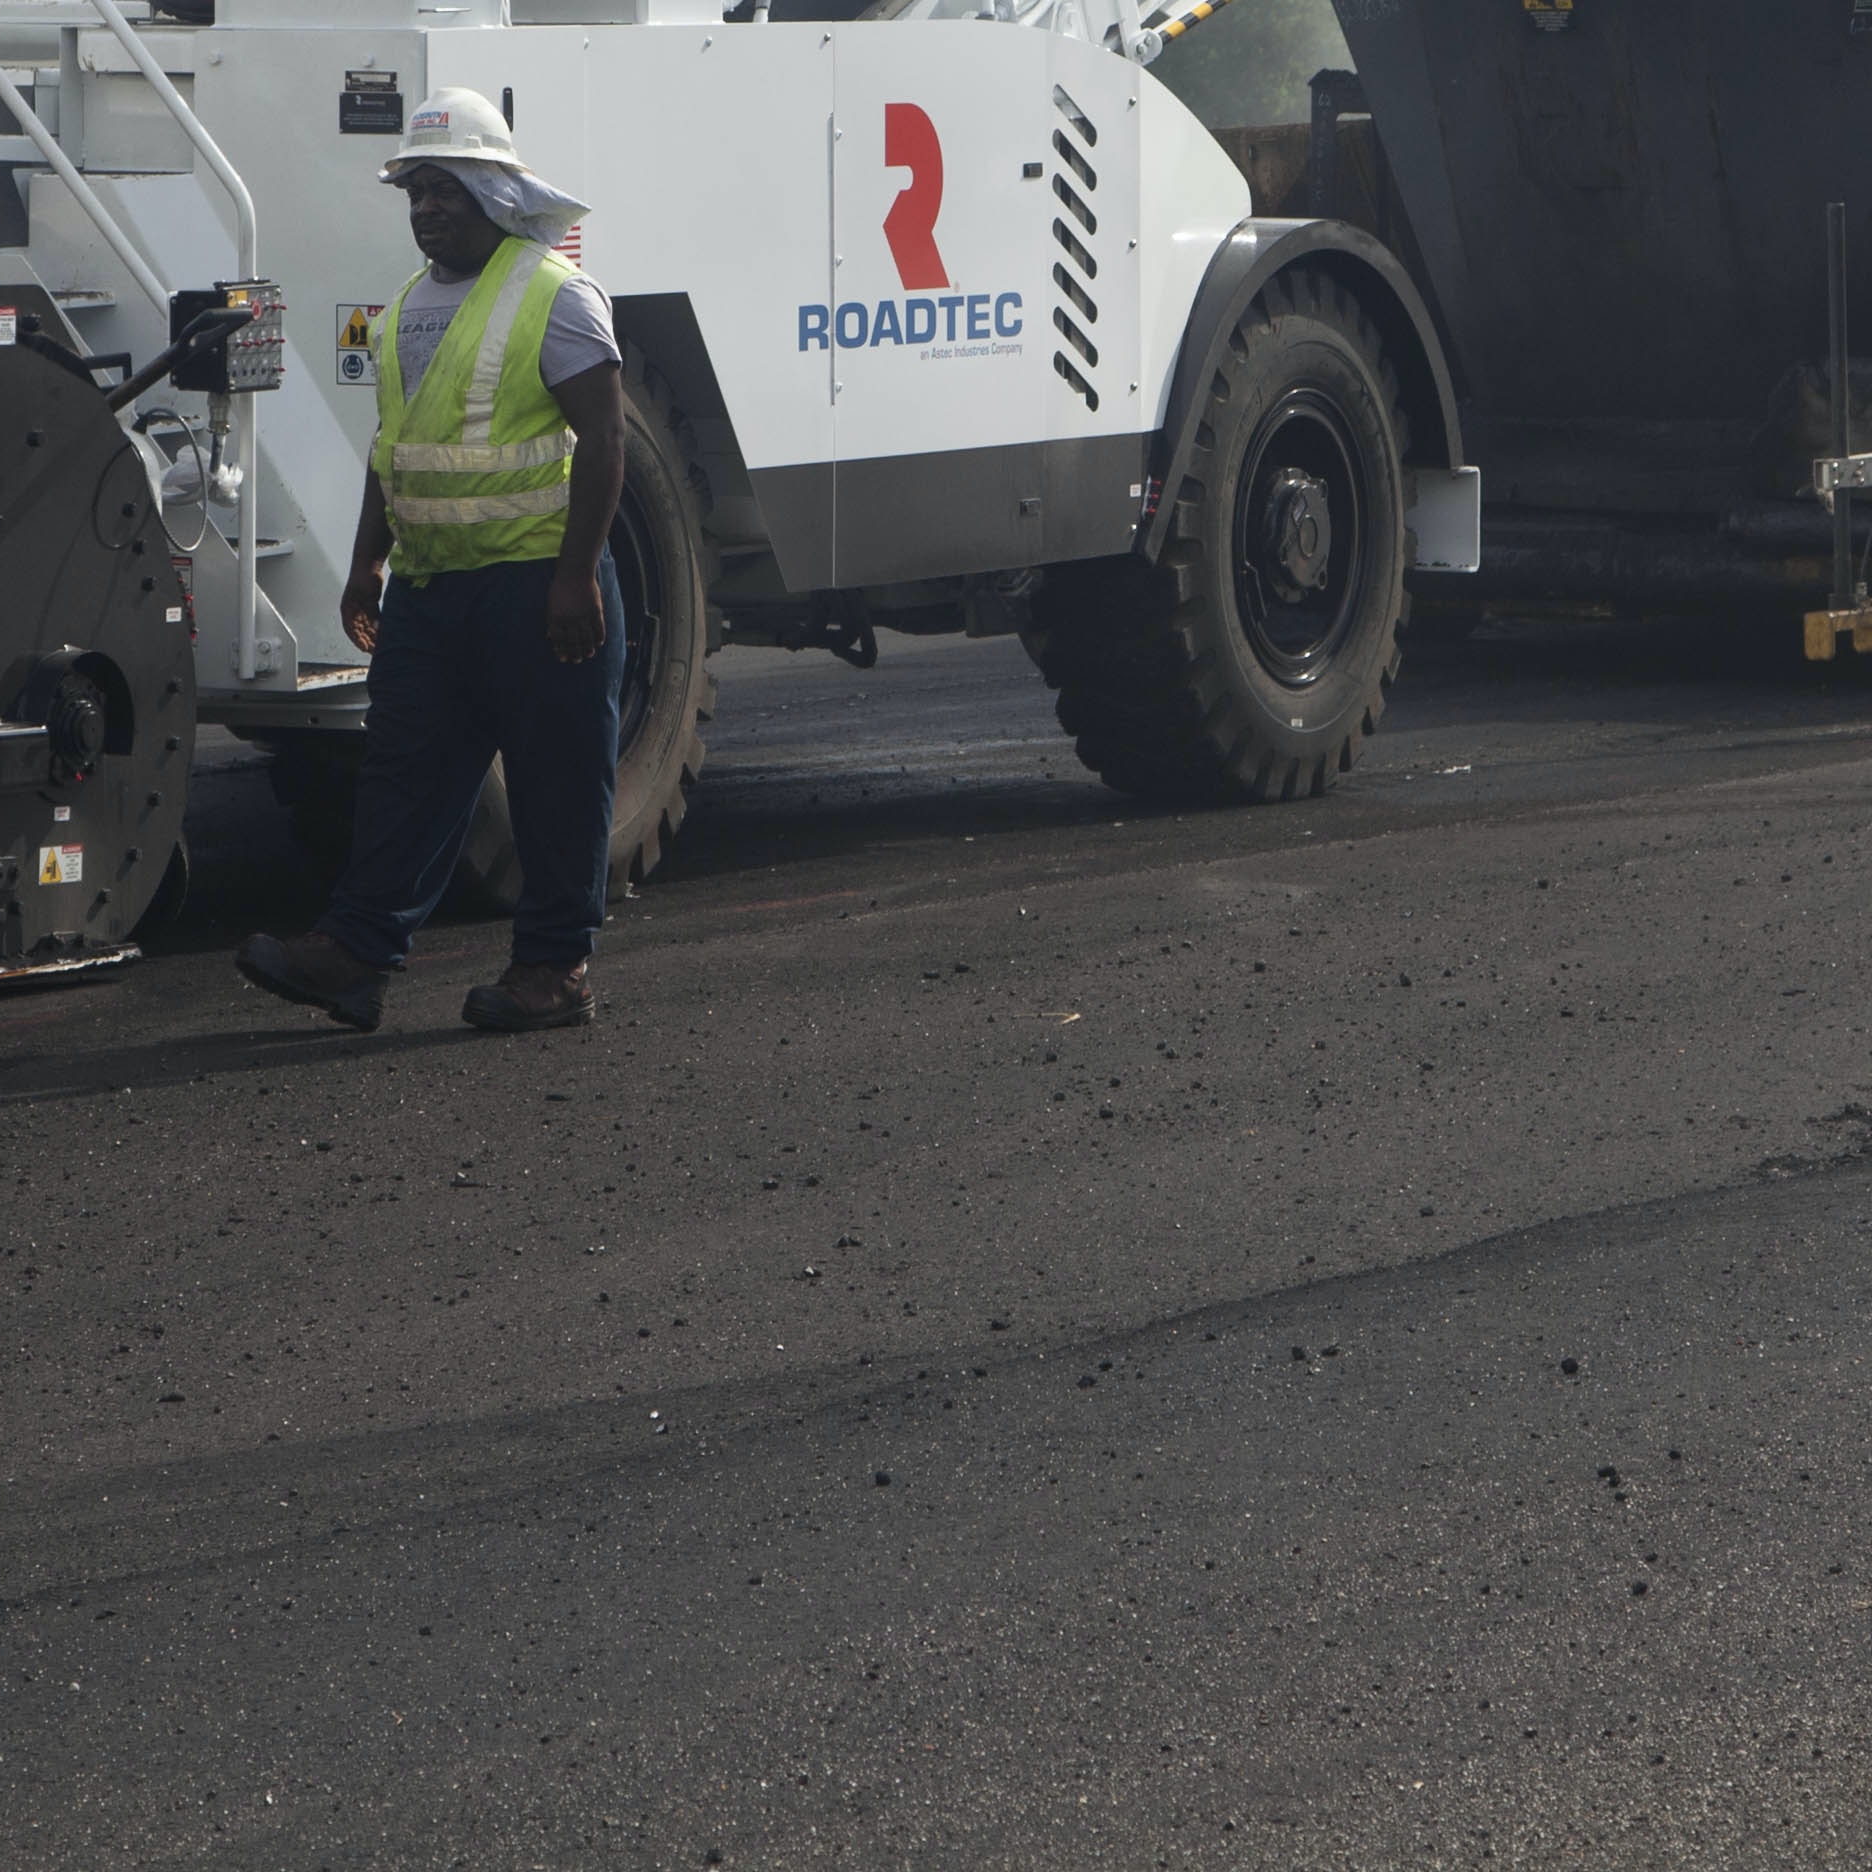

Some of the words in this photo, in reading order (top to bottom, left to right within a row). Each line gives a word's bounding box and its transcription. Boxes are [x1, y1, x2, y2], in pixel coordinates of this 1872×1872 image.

[798, 292, 1023, 352] ROADTEC
[920, 350, 930, 360] an
[931, 346, 953, 359] Astec
[954, 344, 989, 358] Industries
[991, 341, 1024, 357] Company
